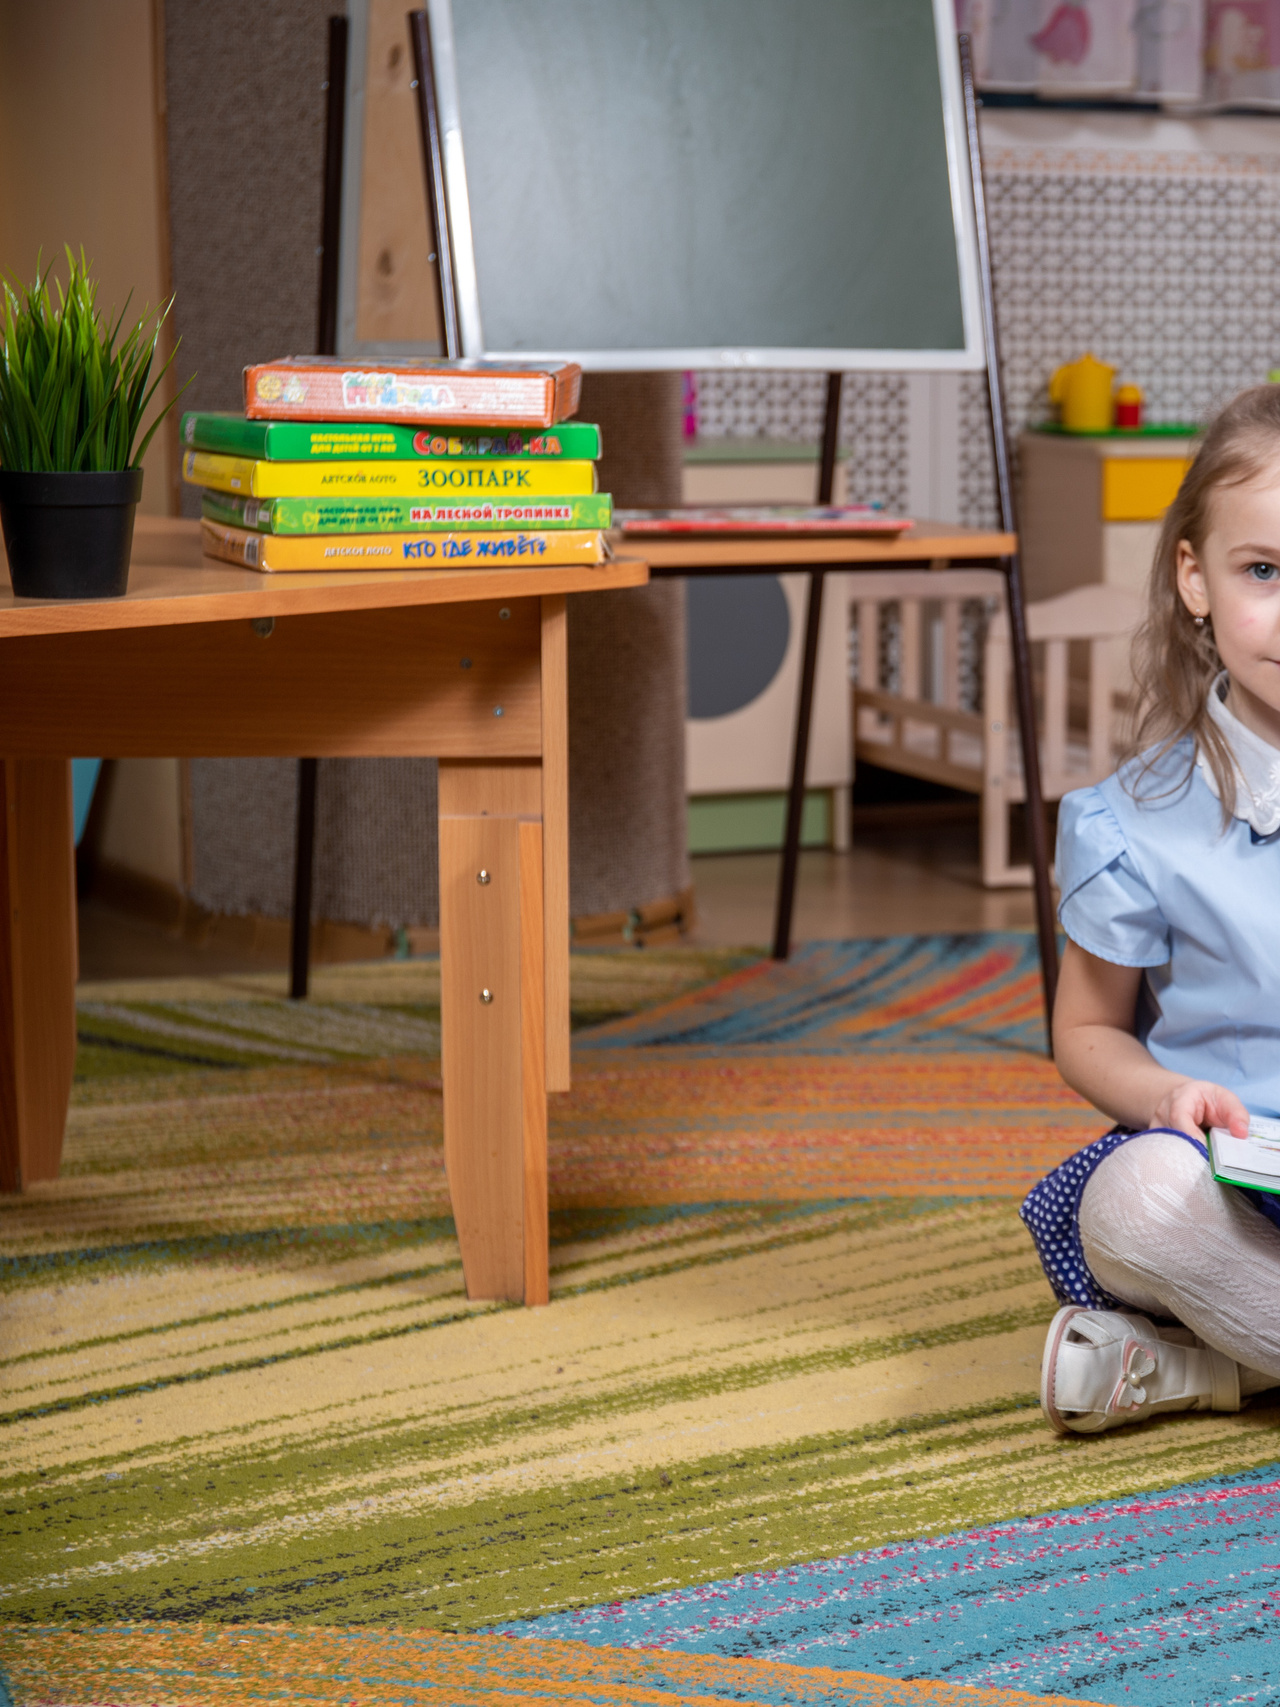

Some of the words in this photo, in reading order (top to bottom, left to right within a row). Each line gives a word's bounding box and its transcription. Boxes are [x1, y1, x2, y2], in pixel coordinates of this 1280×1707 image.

[345, 384, 453, 407] ПРИРОДА
[369, 474, 397, 484] ЛОТО
[418, 469, 531, 488] ЗООПАРК
[411, 507, 432, 521] НА
[435, 504, 493, 520] ЛЕСНОЙ
[496, 507, 571, 520] ТРОПИНКЕ
[324, 546, 365, 558] ДЕТСКОЕ
[366, 546, 392, 556] ЛОТО
[403, 540, 436, 558] КТО
[442, 538, 472, 558] ГДЕ
[475, 534, 547, 557] ЖИВЁТ?
